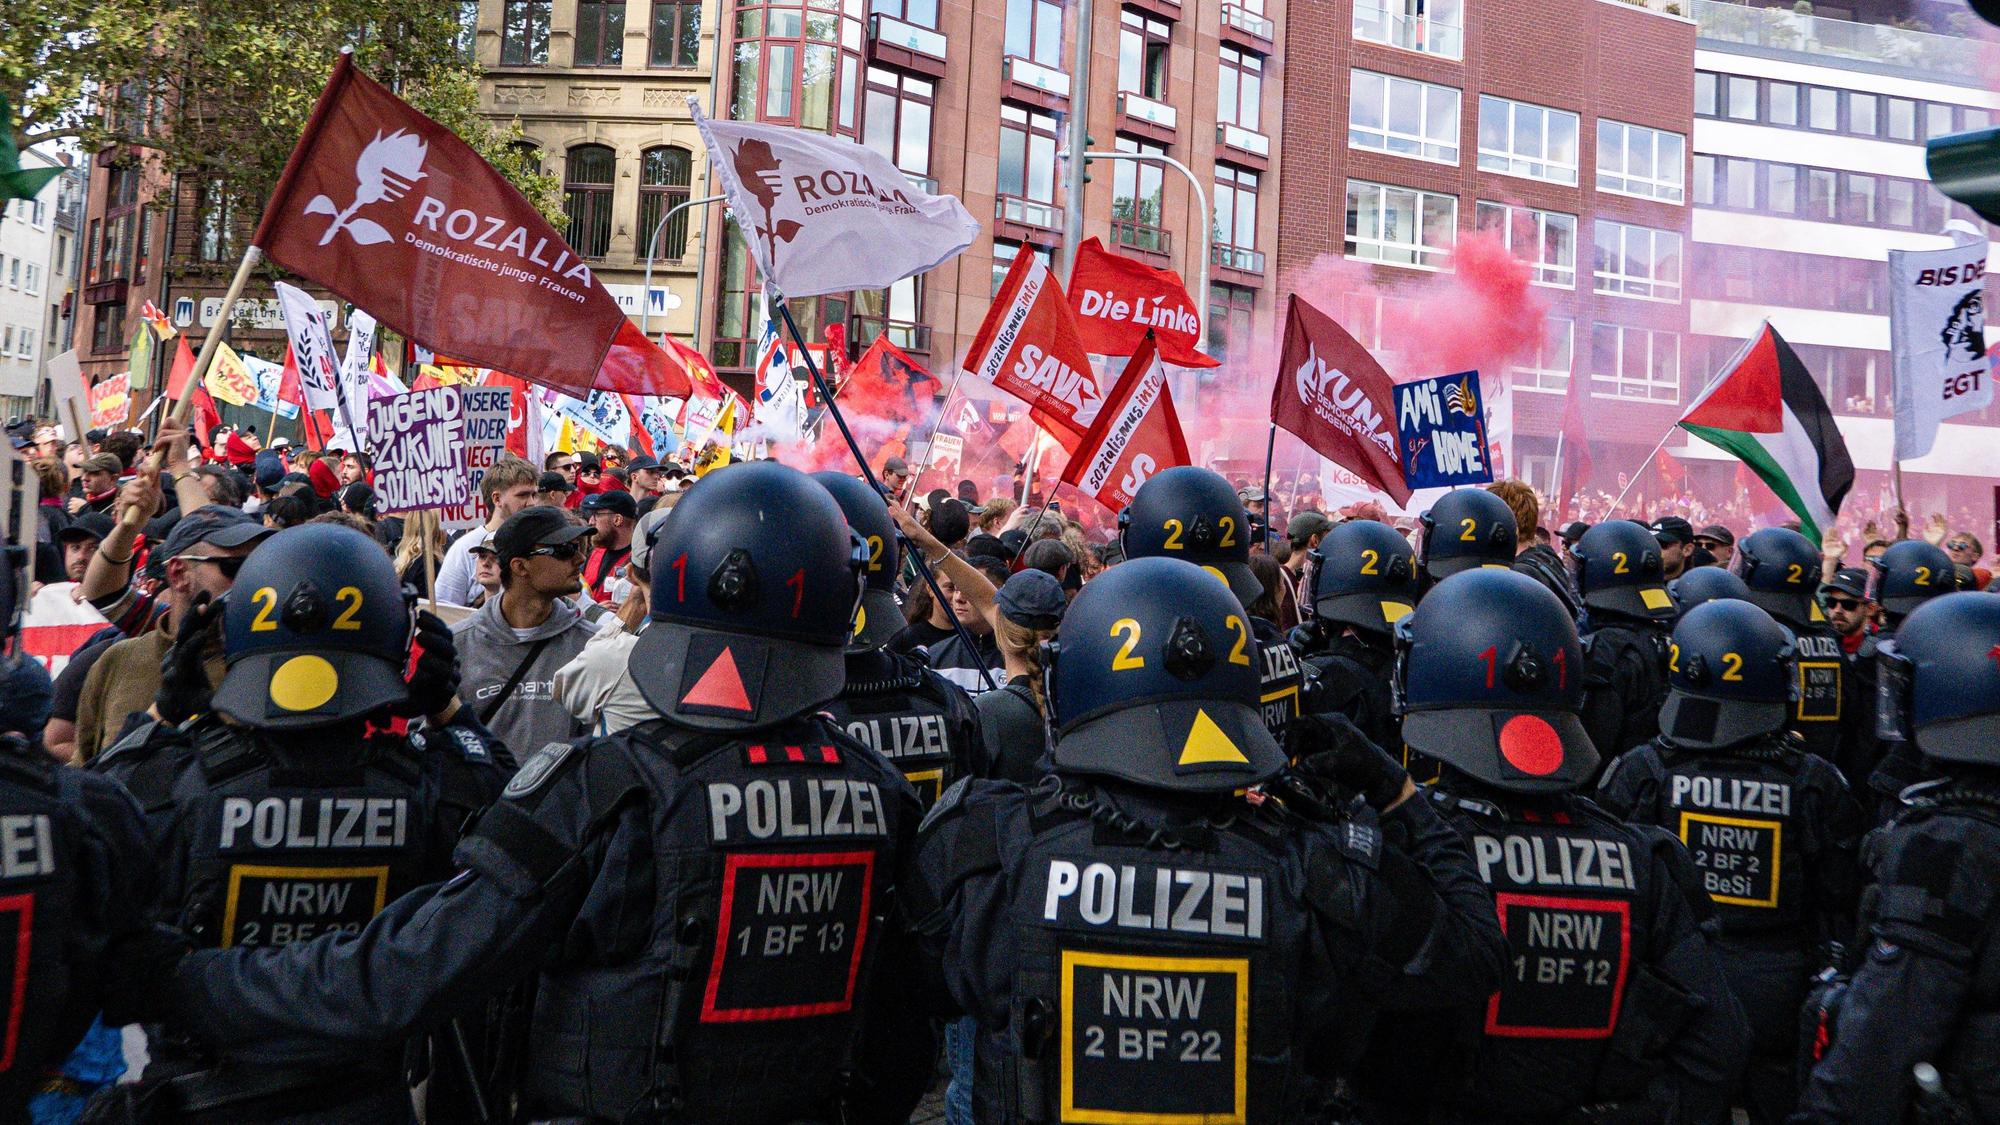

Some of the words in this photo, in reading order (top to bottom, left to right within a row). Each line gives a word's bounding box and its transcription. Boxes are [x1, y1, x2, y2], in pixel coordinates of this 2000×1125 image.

[413, 196, 592, 289] ROZALIA
[404, 232, 499, 272] Demokratische
[498, 263, 537, 284] junge
[539, 277, 586, 304] Frauen
[1917, 266, 1959, 286] BIS
[1961, 259, 1986, 283] DE
[987, 280, 1038, 376] sozialismus.info
[1080, 289, 1130, 321] Die
[1132, 295, 1197, 335] Linke
[463, 392, 511, 412] NSERE
[466, 418, 507, 440] NDER
[1090, 375, 1160, 490] sozialismus.info
[1315, 406, 1352, 437] JUGEND
[374, 420, 464, 476] ZUKUNFT
[468, 446, 503, 468] IEGT
[441, 496, 488, 522] NICH
[1163, 519, 1184, 550] 2
[1219, 516, 1236, 548] 2
[1460, 518, 1477, 541] 2
[867, 535, 884, 571] 2
[1360, 549, 1378, 575] 2
[1612, 552, 1629, 574] 2
[672, 553, 688, 603] 1
[787, 568, 805, 618] 1
[1787, 564, 1802, 583] 2
[1914, 567, 1931, 586] 2
[251, 586, 278, 632] 2
[333, 586, 363, 630] 2
[1110, 618, 1145, 672] 2
[1225, 614, 1250, 667] 2
[1796, 637, 1841, 657] OLIZEI
[1478, 646, 1497, 689] 1
[1553, 647, 1567, 689] 1
[1722, 652, 1743, 681] 2
[848, 715, 949, 759] OLIZEI
[708, 779, 887, 841] POLIZEI
[1671, 774, 1791, 817] POLIZEI
[219, 797, 406, 849] POLIZEI
[1700, 825, 1759, 851] NRW
[1473, 835, 1636, 890] POLIZEI
[1695, 850, 1708, 867] 2
[1713, 852, 1742, 871] BF
[1747, 856, 1760, 874] 2
[262, 881, 350, 915] NRW
[757, 871, 843, 915] NRW
[1044, 860, 1262, 938] POLIZEI
[1704, 870, 1752, 896] BeSi
[241, 921, 261, 945] 2
[737, 926, 751, 956] 1
[764, 924, 807, 957] BF
[817, 922, 845, 955] 13
[1527, 911, 1602, 951] NRW
[1513, 955, 1525, 981] 1
[1537, 957, 1575, 985] BF
[1584, 959, 1612, 986] 12
[1103, 974, 1206, 1020] NRW
[1085, 1025, 1105, 1058] 2
[1118, 1027, 1168, 1061] BF
[1180, 1030, 1221, 1062] 22
